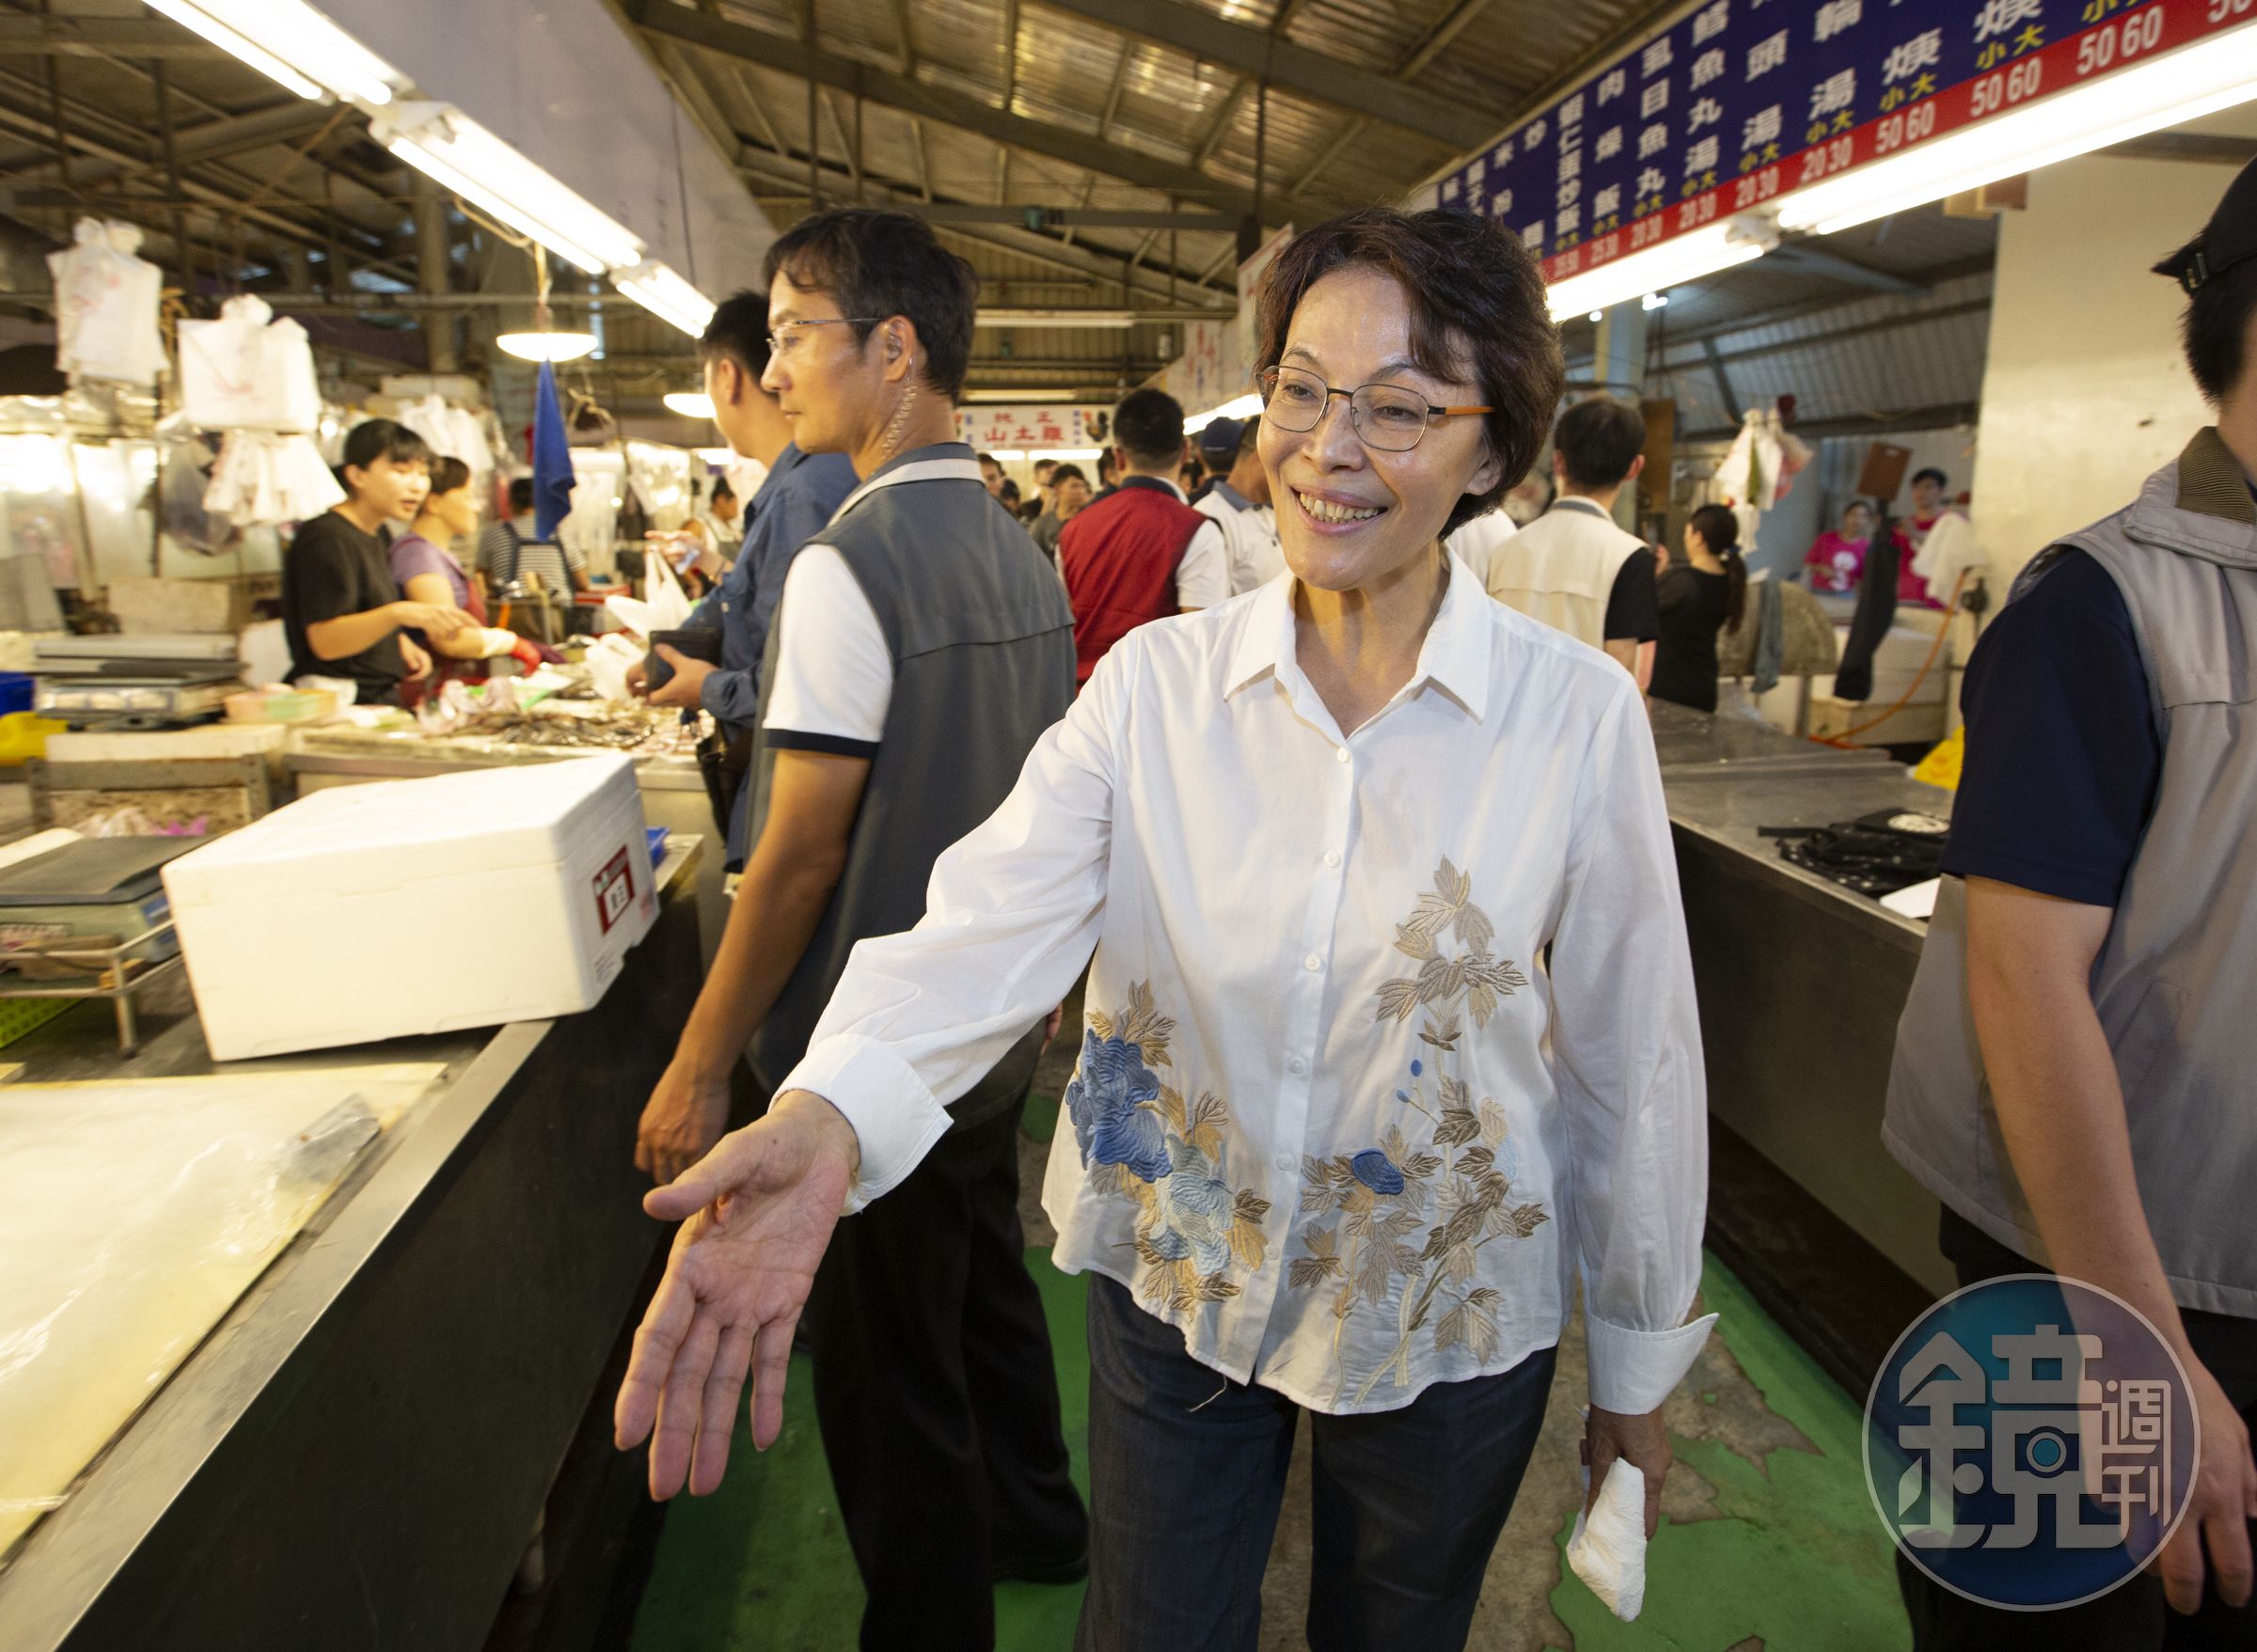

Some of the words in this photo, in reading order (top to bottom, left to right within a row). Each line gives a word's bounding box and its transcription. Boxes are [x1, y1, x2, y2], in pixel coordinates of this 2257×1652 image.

[2076, 24, 2116, 75] 50
[2121, 5, 2164, 58] 60
[1742, 0, 1789, 151] 頭湯
[1970, 73, 2003, 118] 50
[2007, 55, 2043, 103] 60
[1800, 146, 1827, 182] 20
[1827, 135, 1854, 172] 30
[1875, 114, 1903, 154] 50
[1905, 100, 1936, 142] 60
